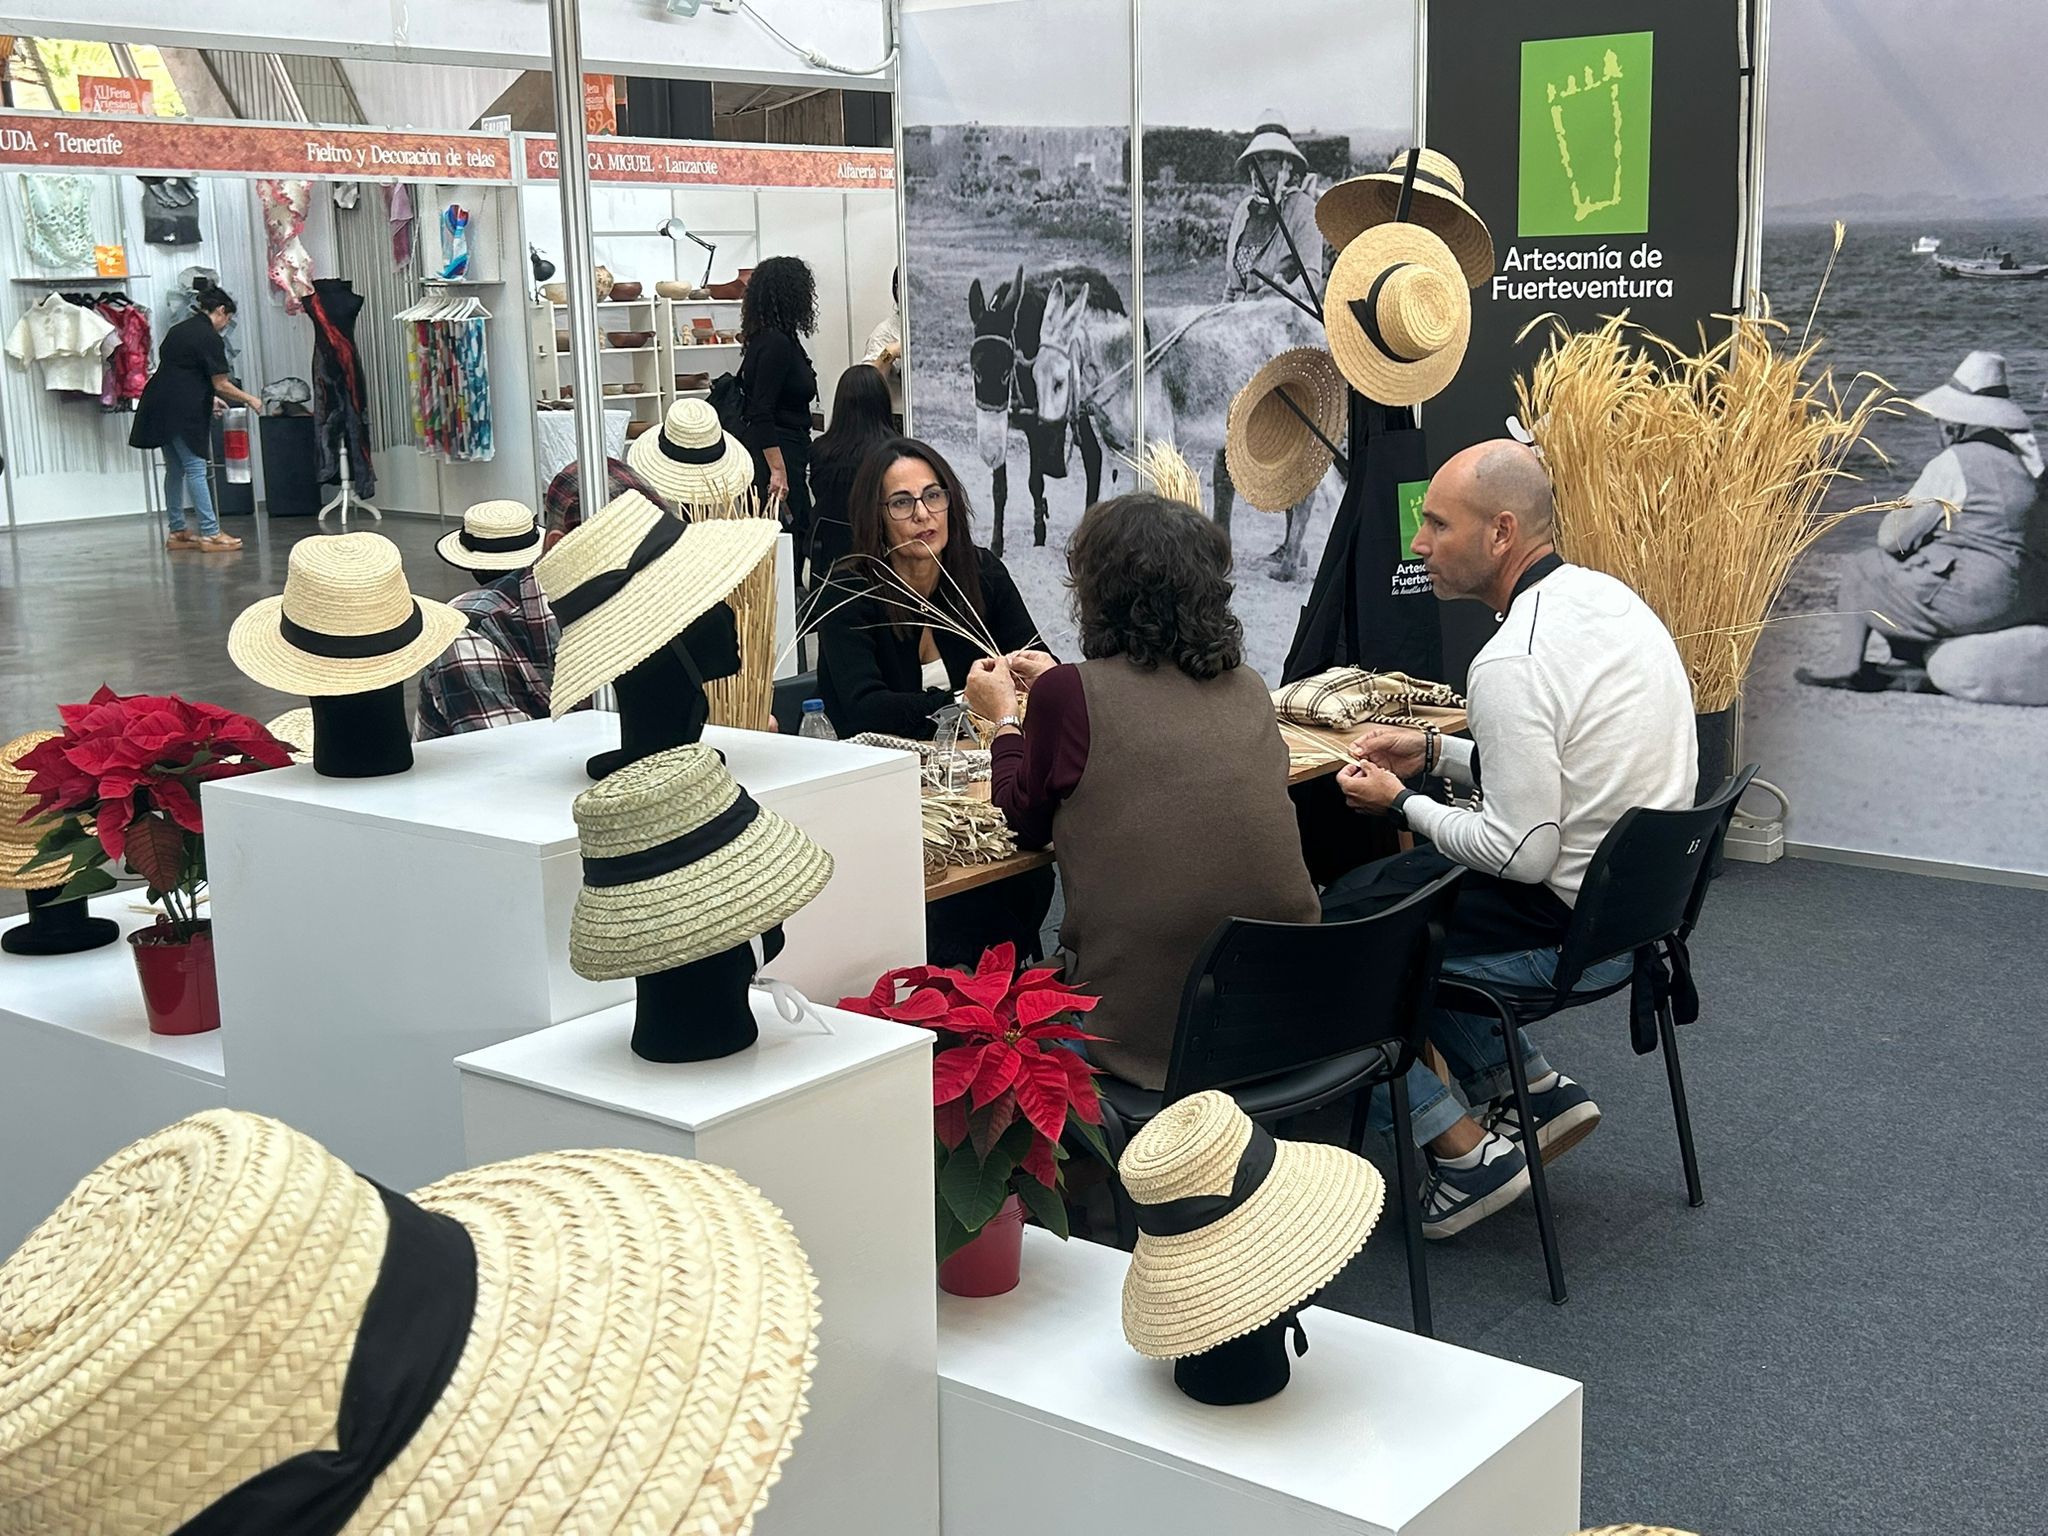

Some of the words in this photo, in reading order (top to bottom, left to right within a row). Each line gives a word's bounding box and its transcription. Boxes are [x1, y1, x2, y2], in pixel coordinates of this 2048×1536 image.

[54, 131, 123, 155] Tenerife
[305, 142, 352, 163] Fieltro
[356, 148, 367, 169] y
[370, 144, 442, 167] Decoración
[446, 147, 463, 167] de
[466, 148, 496, 168] telas
[607, 153, 655, 173] MIGUEL
[665, 155, 719, 175] Lanzarote
[1502, 244, 1622, 272] Artesanía
[1629, 243, 1663, 270] de
[1492, 274, 1674, 301] Fuerteventura
